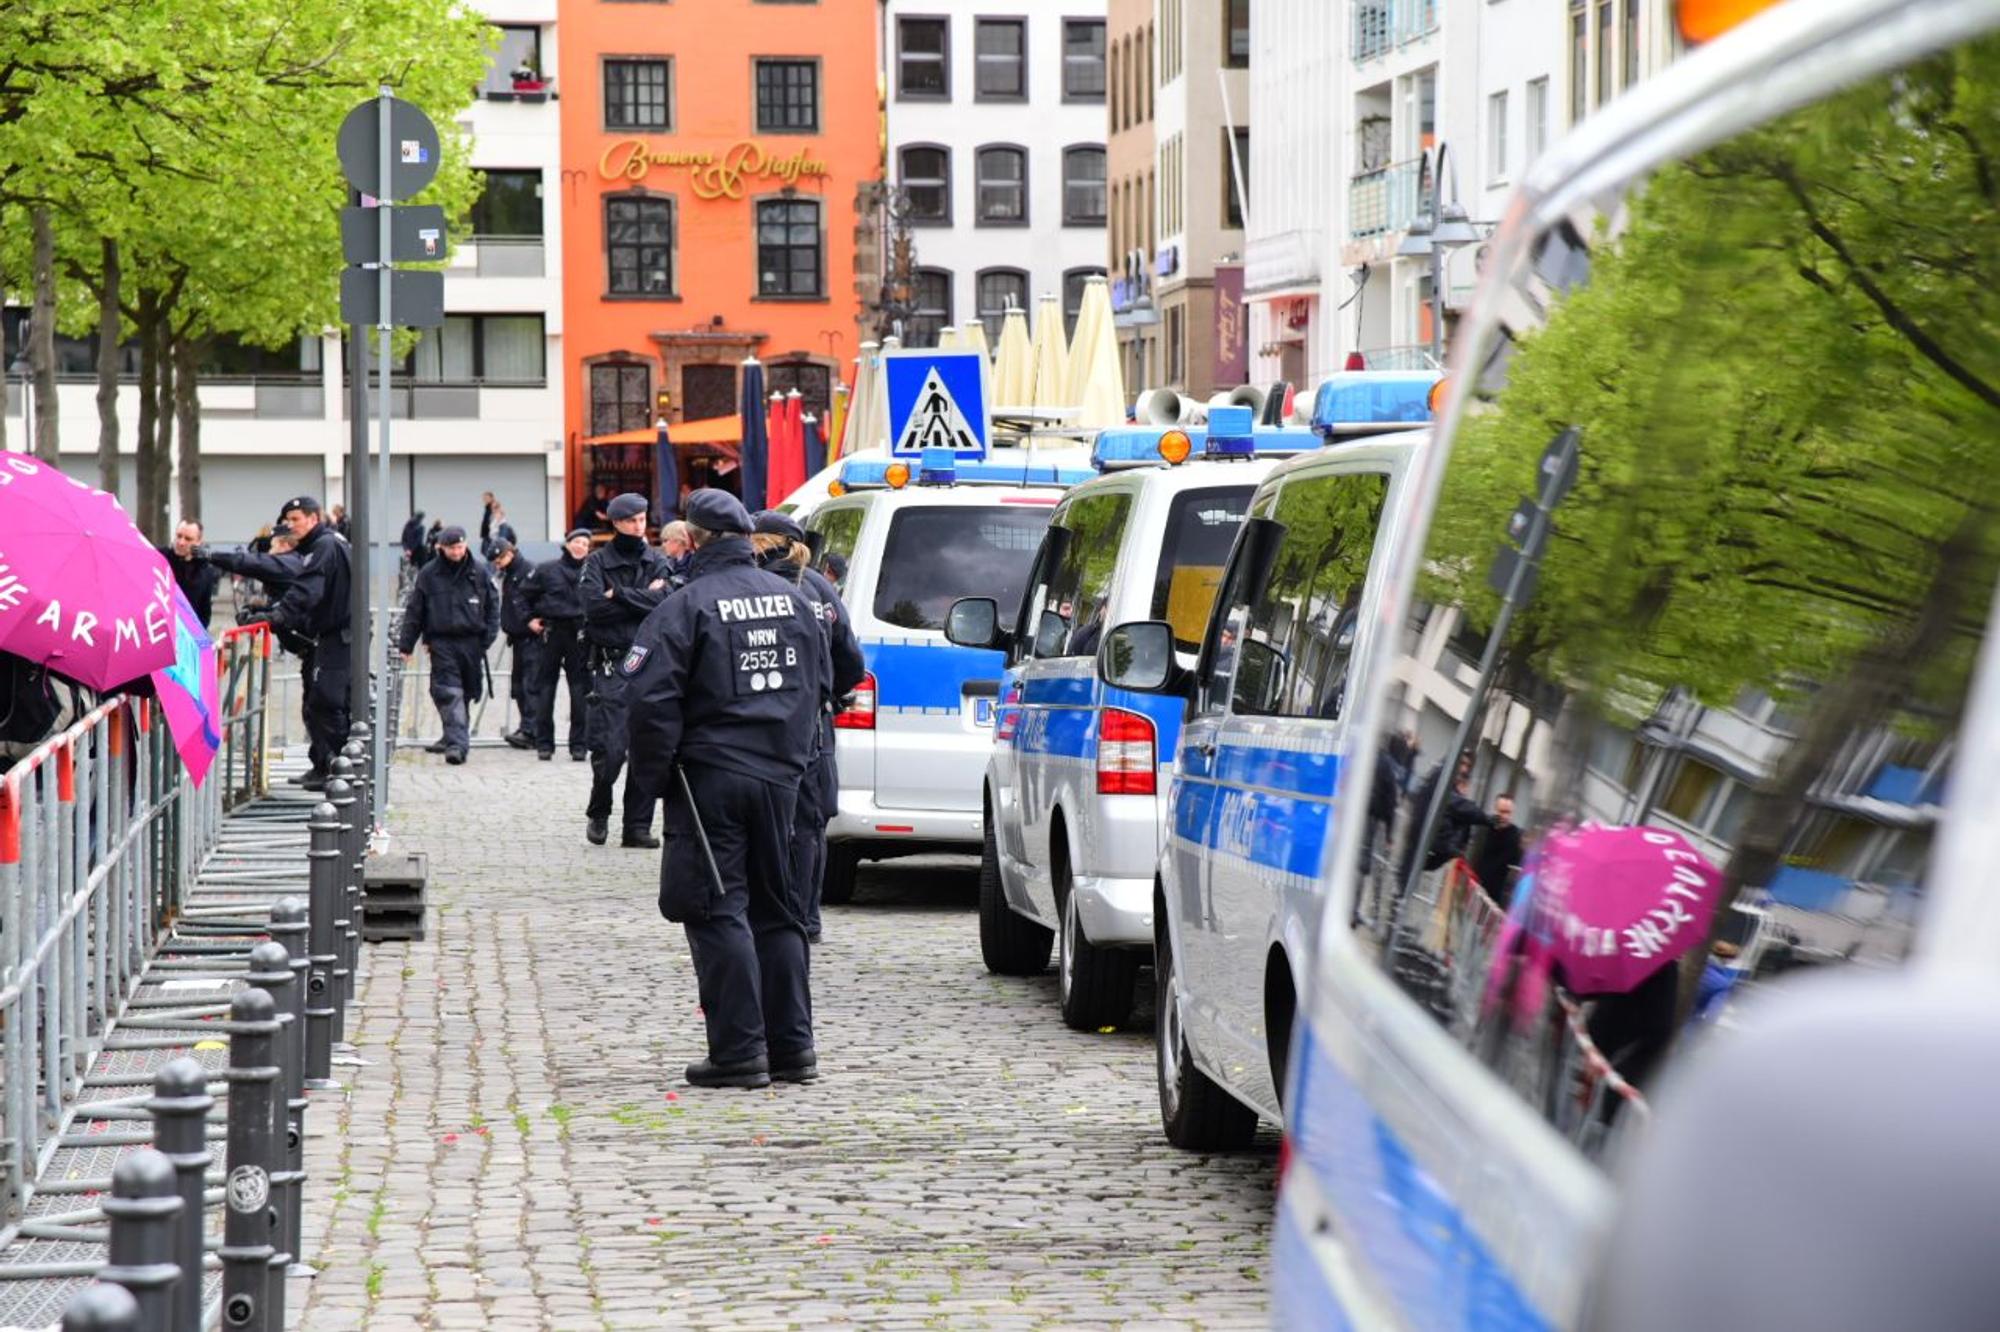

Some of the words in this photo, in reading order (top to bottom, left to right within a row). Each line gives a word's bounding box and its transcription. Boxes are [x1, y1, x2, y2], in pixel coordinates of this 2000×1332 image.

[691, 139, 829, 199] Pfaffen
[717, 595, 795, 622] POLIZEI
[747, 628, 777, 647] NRW
[740, 650, 779, 671] 2552
[786, 647, 797, 666] B
